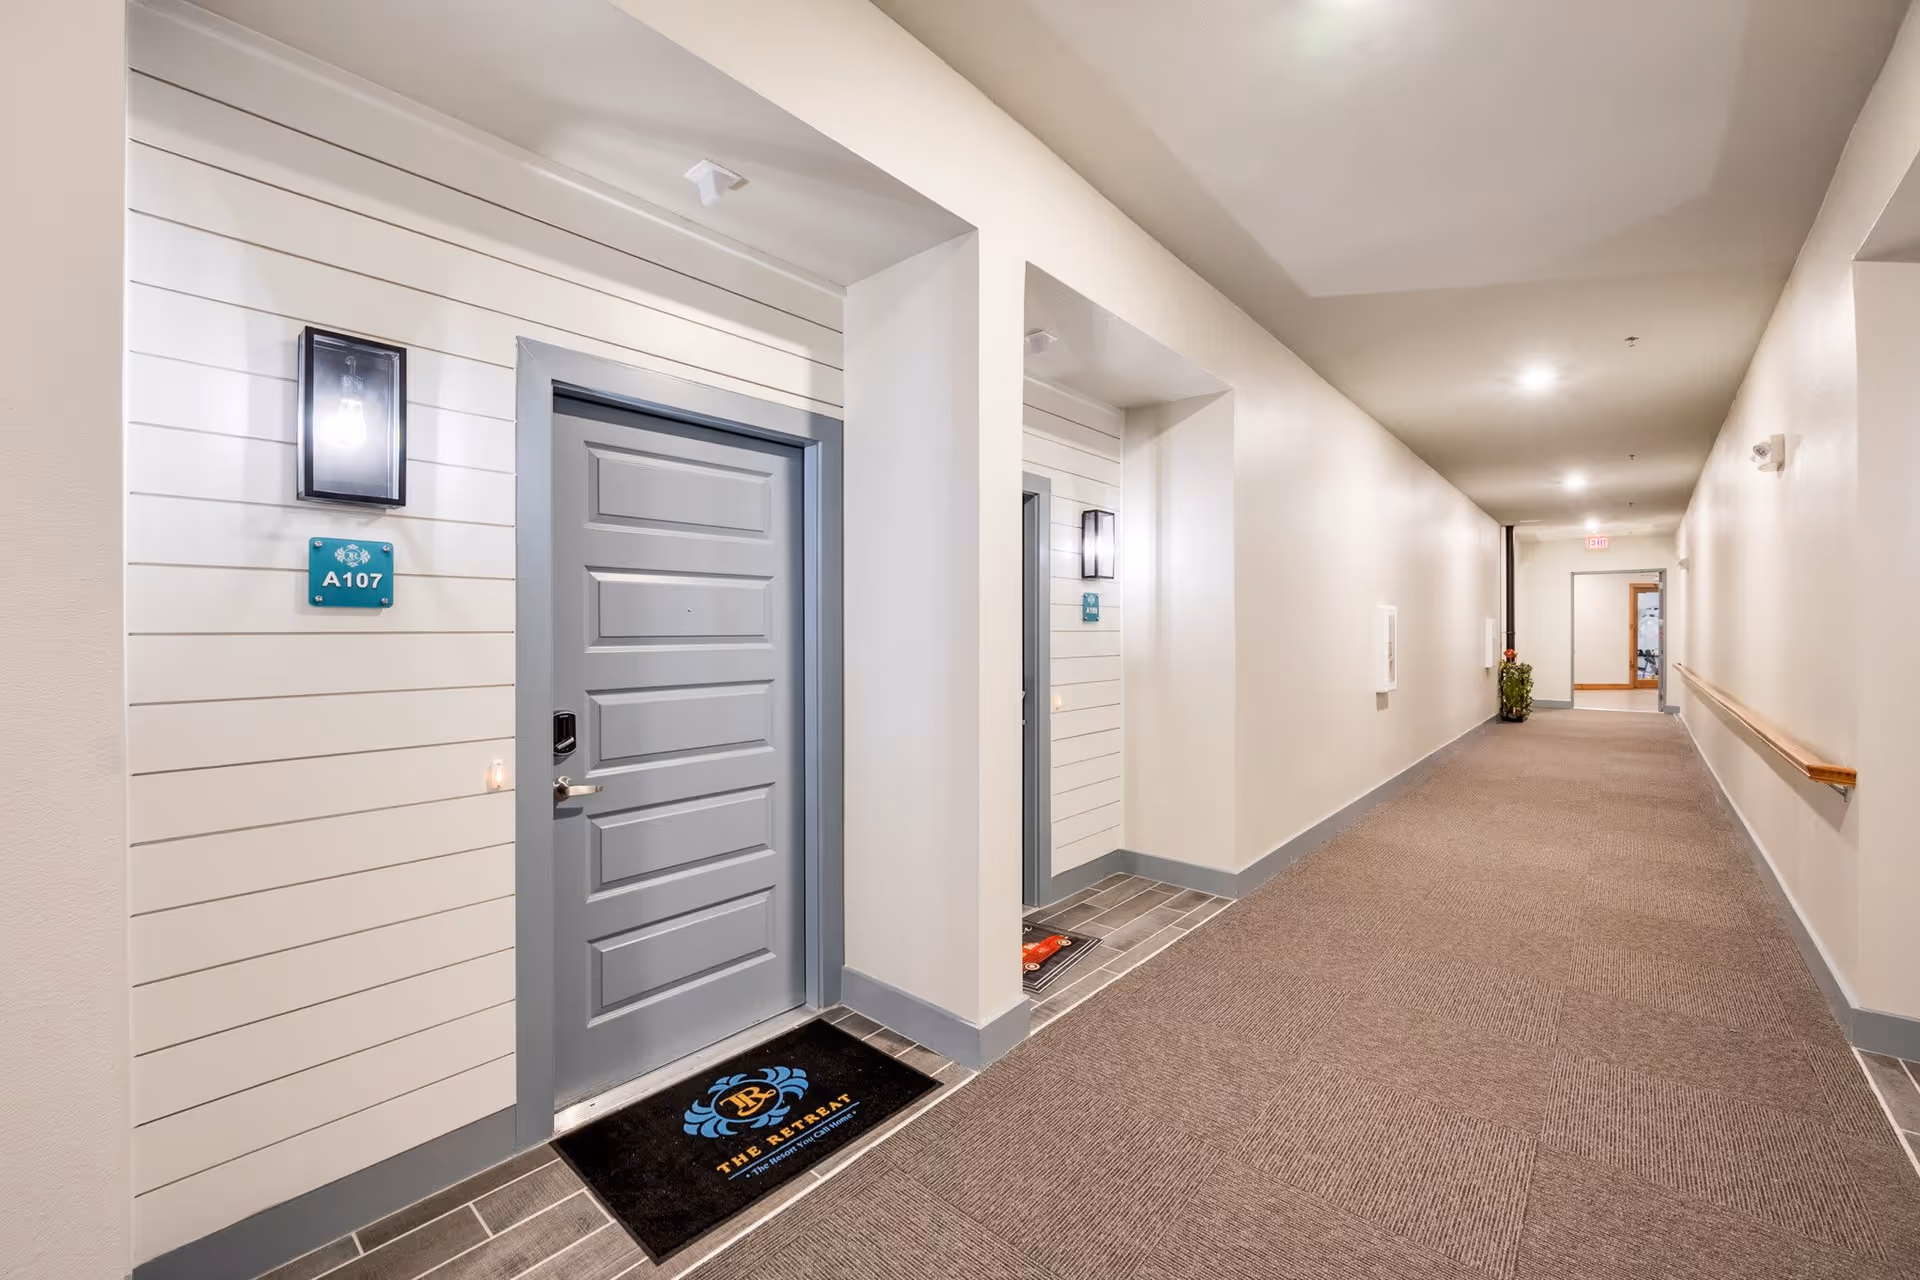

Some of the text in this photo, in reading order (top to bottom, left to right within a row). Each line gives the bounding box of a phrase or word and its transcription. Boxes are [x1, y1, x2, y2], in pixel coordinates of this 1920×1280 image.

[322, 571, 383, 589] A107
[716, 1093, 851, 1174] THE RETREAT
[752, 1114, 853, 1175] The Resort You Call Home
